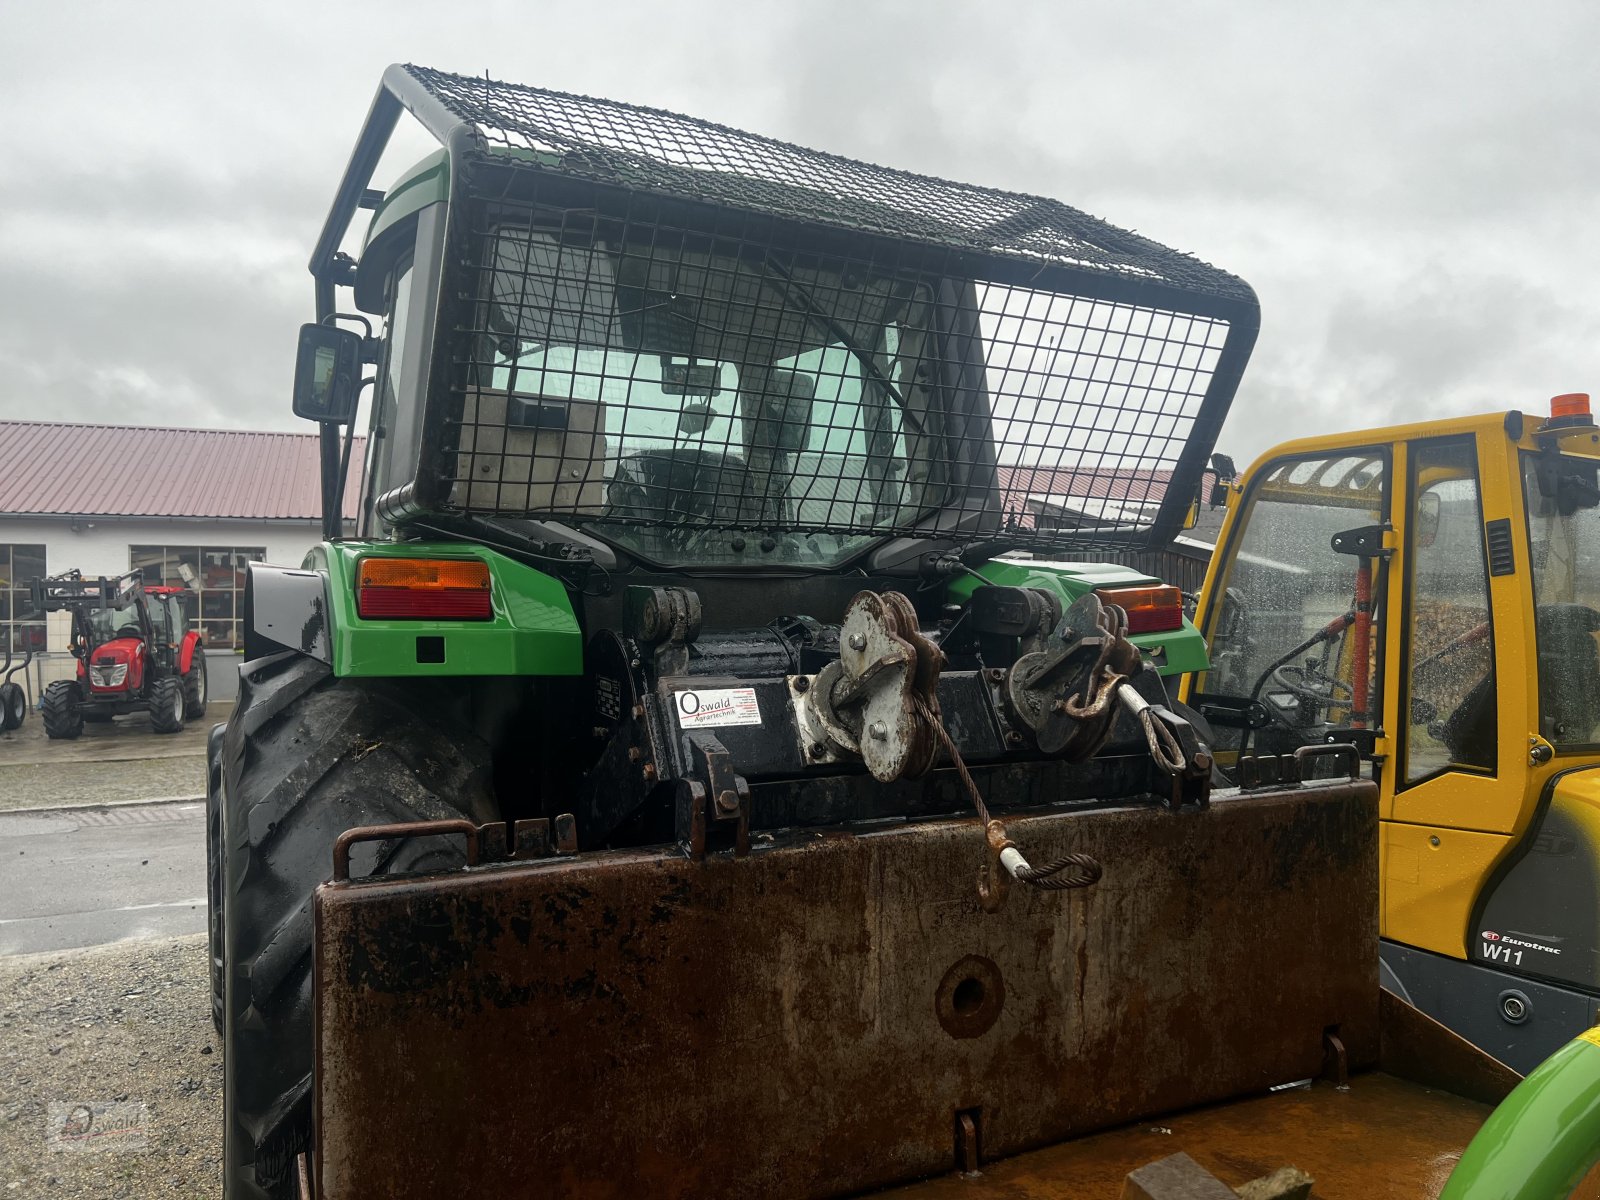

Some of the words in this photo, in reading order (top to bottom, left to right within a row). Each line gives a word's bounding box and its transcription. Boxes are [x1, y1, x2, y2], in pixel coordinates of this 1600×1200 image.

[680, 692, 731, 715] Oswald
[694, 709, 736, 722] Agrartechnik
[1483, 942, 1523, 965] W11
[1501, 936, 1561, 954] Eurotrac
